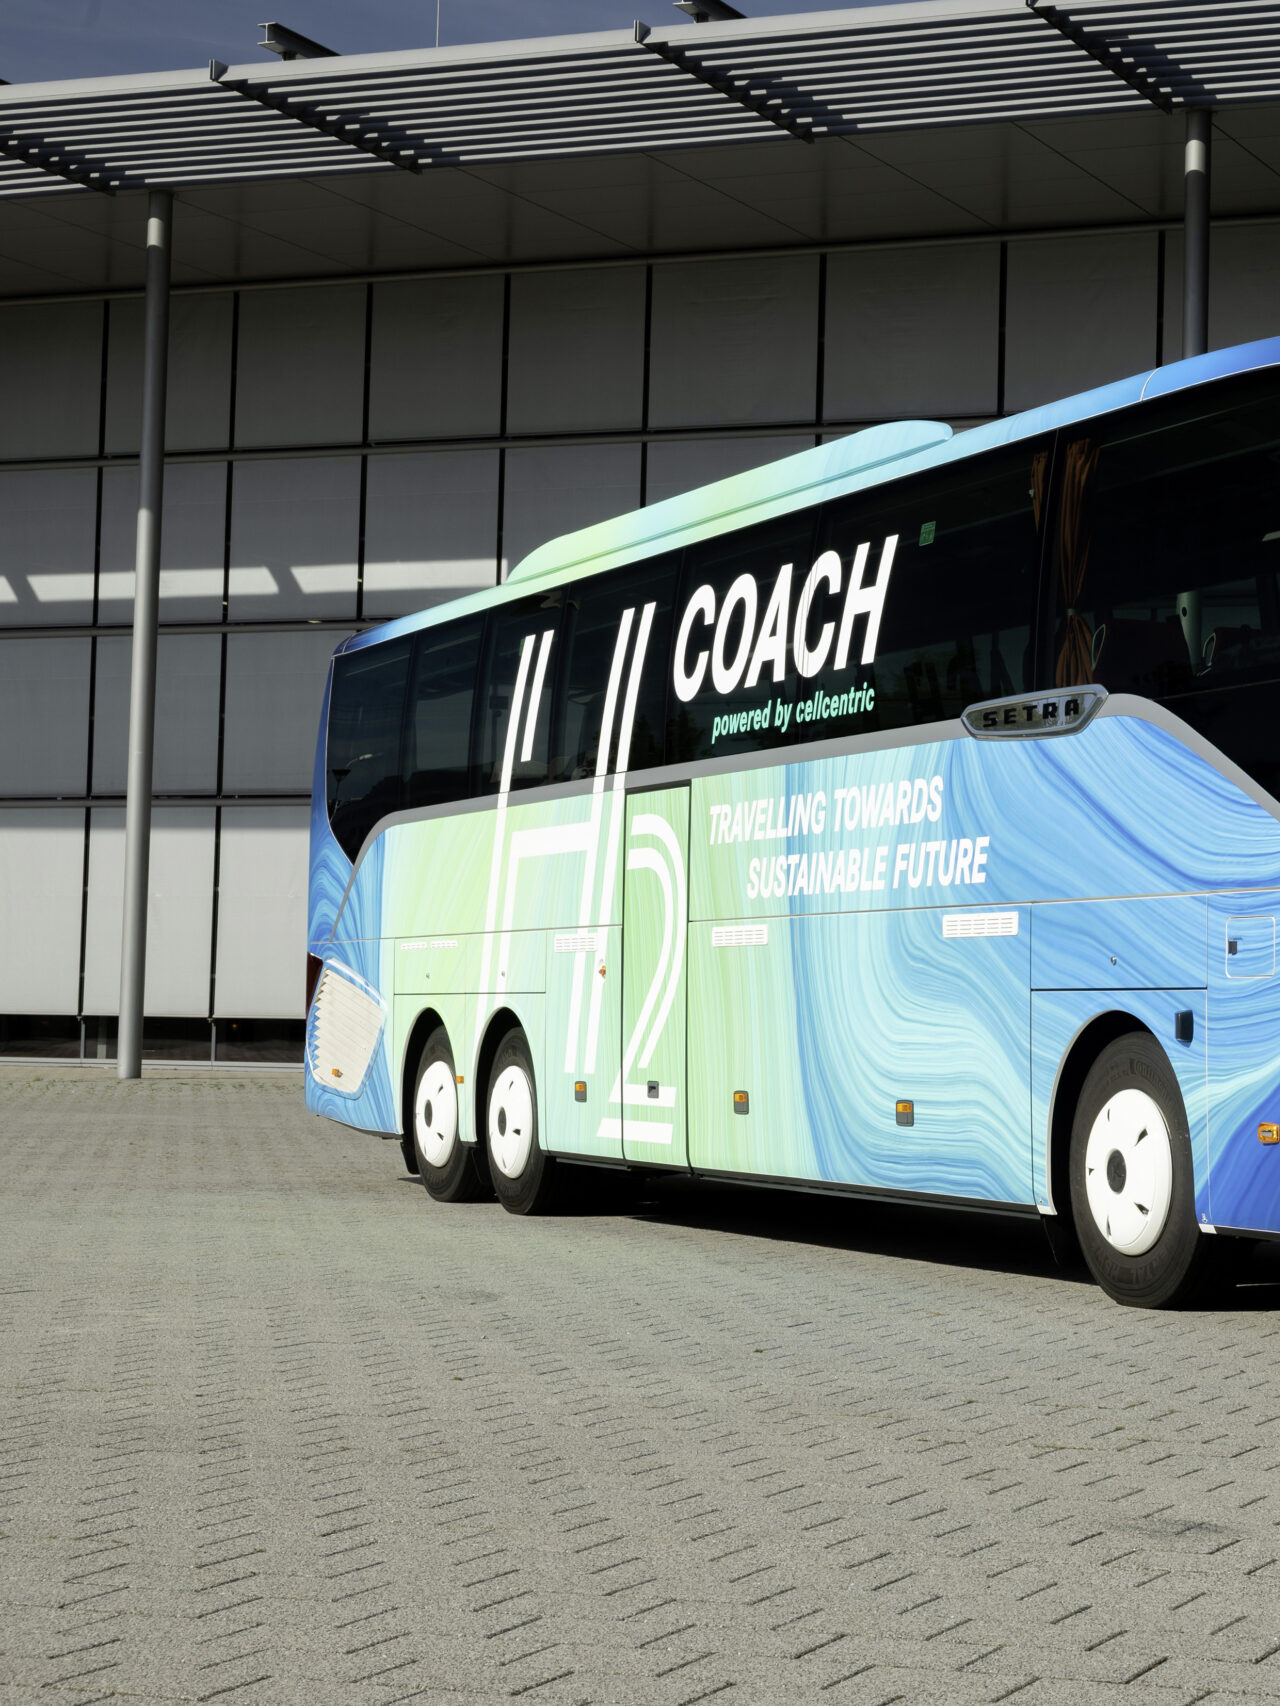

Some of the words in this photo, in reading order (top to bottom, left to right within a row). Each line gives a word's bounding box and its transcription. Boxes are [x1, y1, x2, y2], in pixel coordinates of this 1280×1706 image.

[673, 534, 899, 702] COACH
[711, 700, 772, 744] powered
[773, 698, 794, 733] by
[795, 681, 876, 724] cellcentric
[982, 699, 1080, 728] SETRA
[709, 790, 827, 845] TRAVELLING
[833, 775, 944, 832] TOWARDS
[746, 845, 889, 899] SUSTAINABLE
[892, 836, 990, 889] FUTURE
